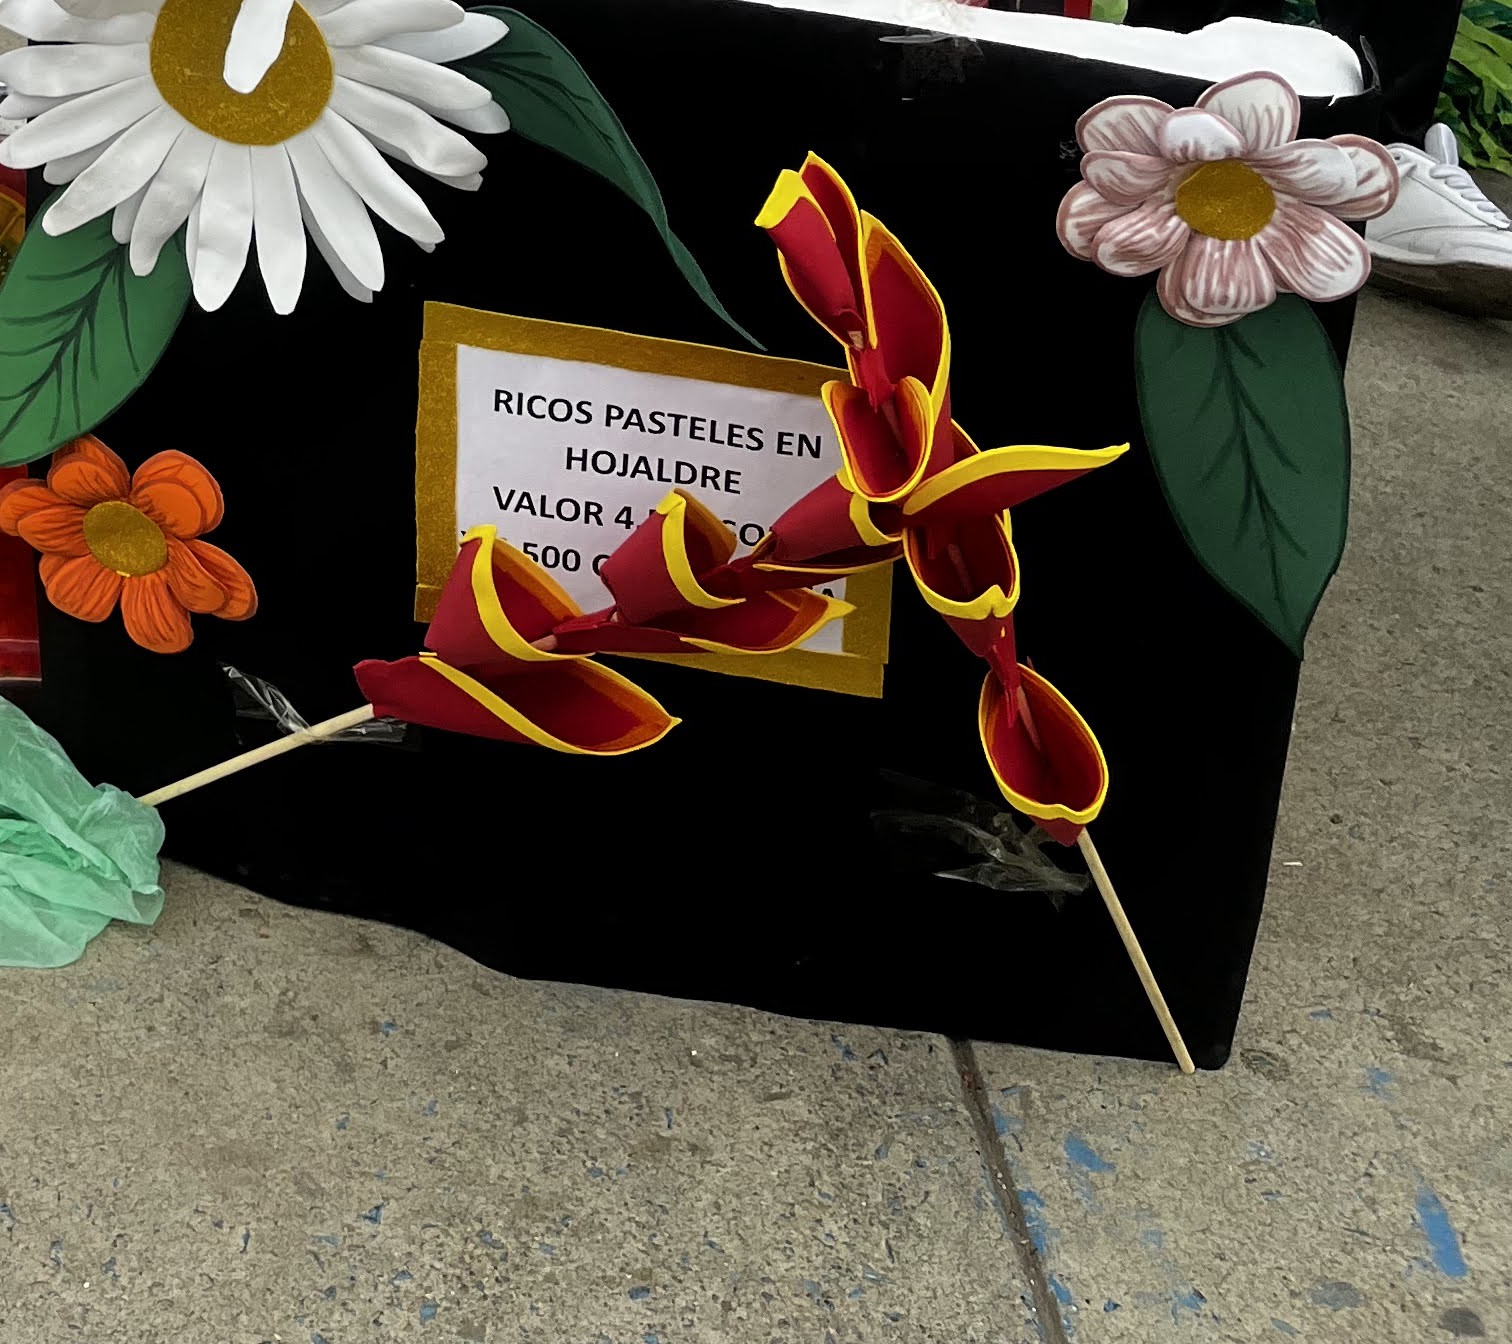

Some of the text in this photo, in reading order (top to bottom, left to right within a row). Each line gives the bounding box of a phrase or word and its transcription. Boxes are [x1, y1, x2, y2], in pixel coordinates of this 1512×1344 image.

[493, 389, 823, 459] RICOS PASTELES EN
[565, 447, 742, 495] HOJALDRE
[492, 487, 604, 526] VALOR
